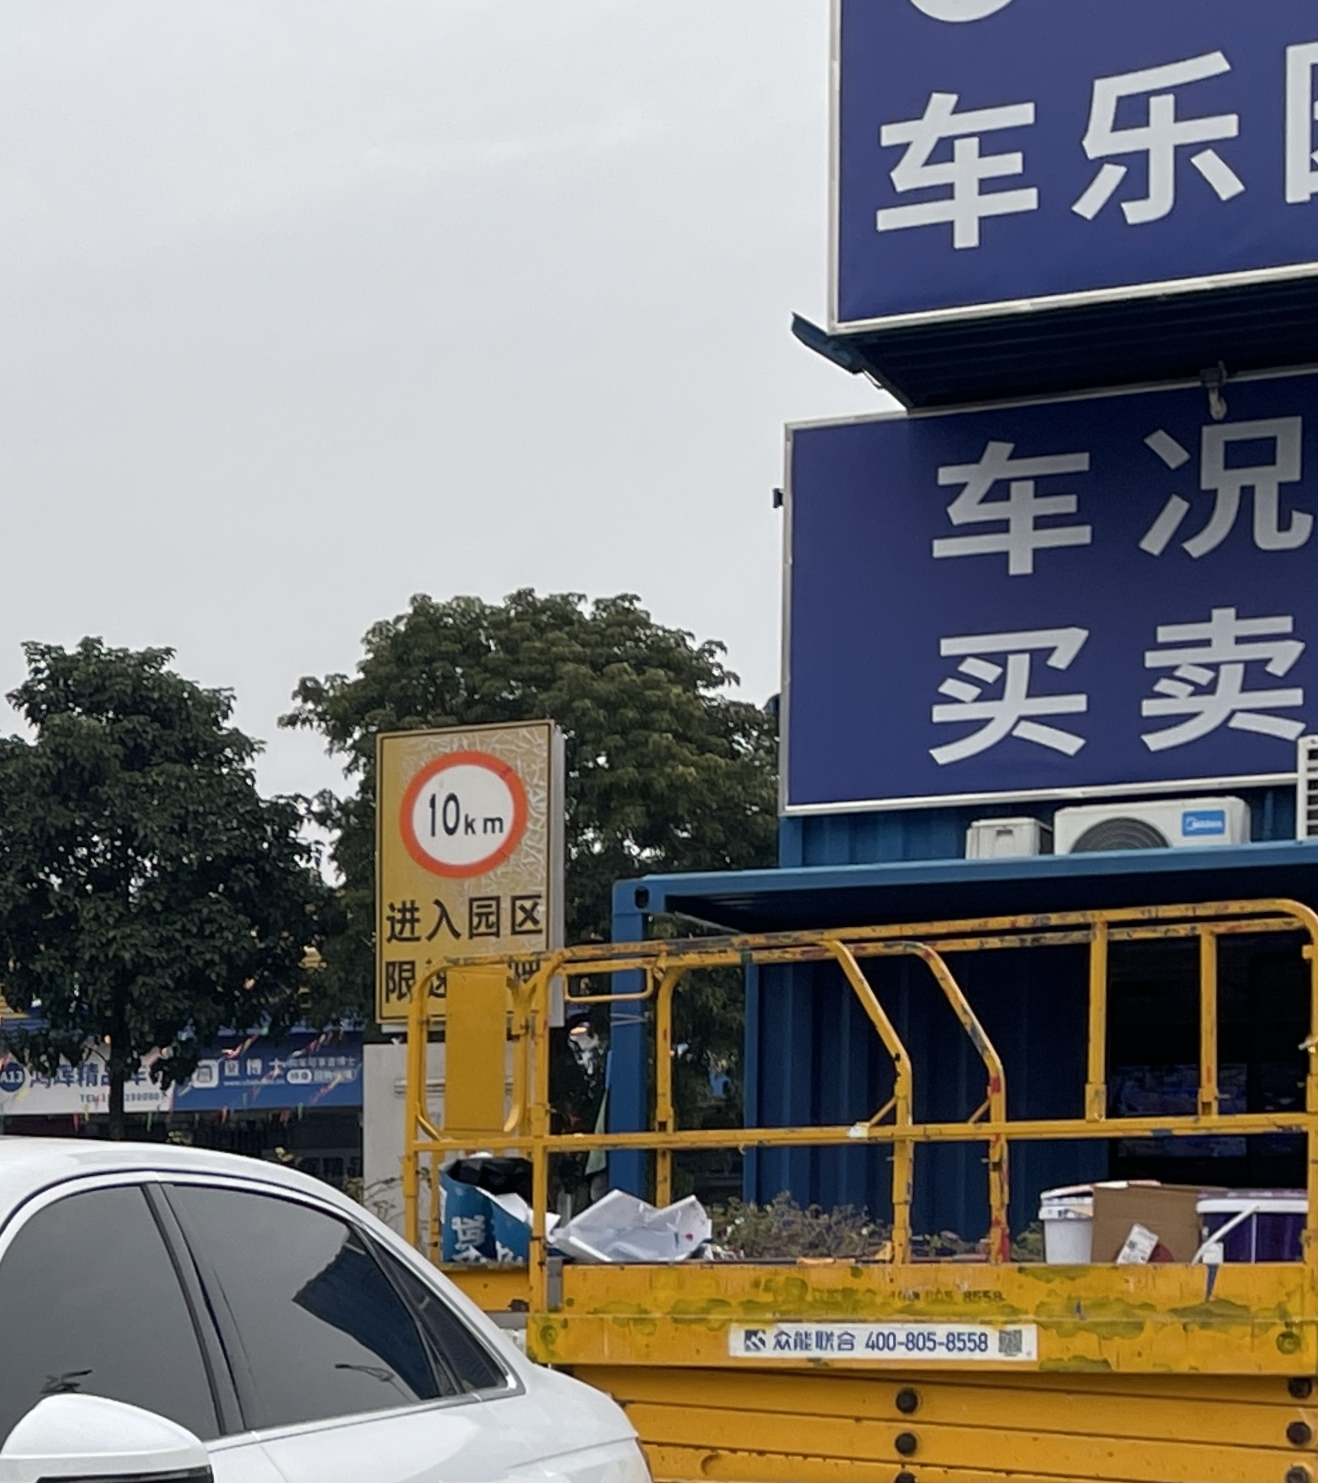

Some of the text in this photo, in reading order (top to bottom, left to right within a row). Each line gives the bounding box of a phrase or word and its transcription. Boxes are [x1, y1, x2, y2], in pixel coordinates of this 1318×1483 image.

[876, 42, 1318, 249] 车乐
[933, 416, 1314, 575] 车况
[929, 607, 1307, 765] 买卖
[429, 793, 504, 837] 10km
[386, 895, 543, 943] 进入园区
[0, 1071, 23, 1084] A13
[773, 1330, 989, 1351] 众能联合 400-805-8558
